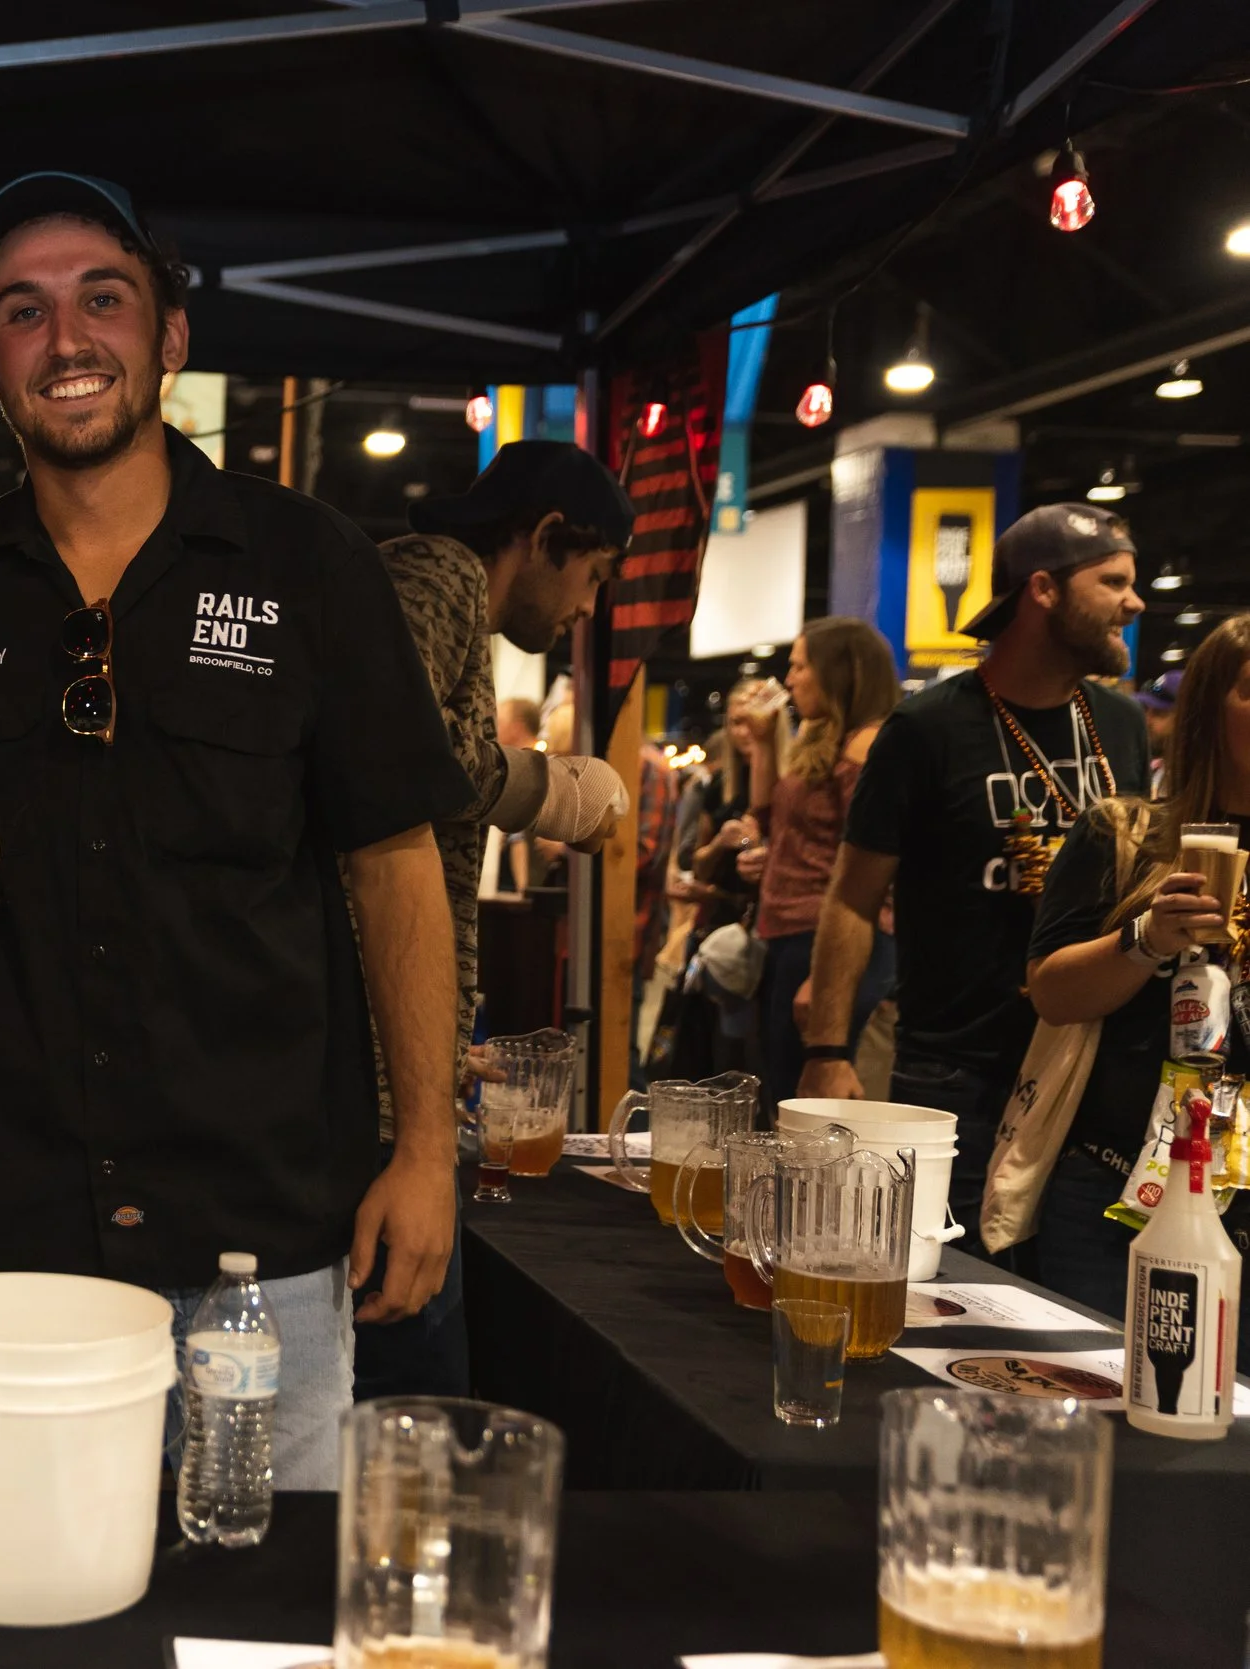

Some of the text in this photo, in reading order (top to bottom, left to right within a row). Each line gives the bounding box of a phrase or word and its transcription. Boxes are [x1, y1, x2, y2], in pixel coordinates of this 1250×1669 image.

[196, 592, 280, 625] RAILS
[192, 619, 248, 649] END
[189, 655, 273, 676] BROOMFIELD, CO
[1150, 1256, 1200, 1270] CERTIFIED
[1150, 1288, 1190, 1311] INDE
[1150, 1306, 1183, 1325] PEN
[1134, 1265, 1147, 1399] BREWERS ASSOCIATION
[1149, 1323, 1194, 1343] DENT
[1148, 1338, 1190, 1354] CRAFT
